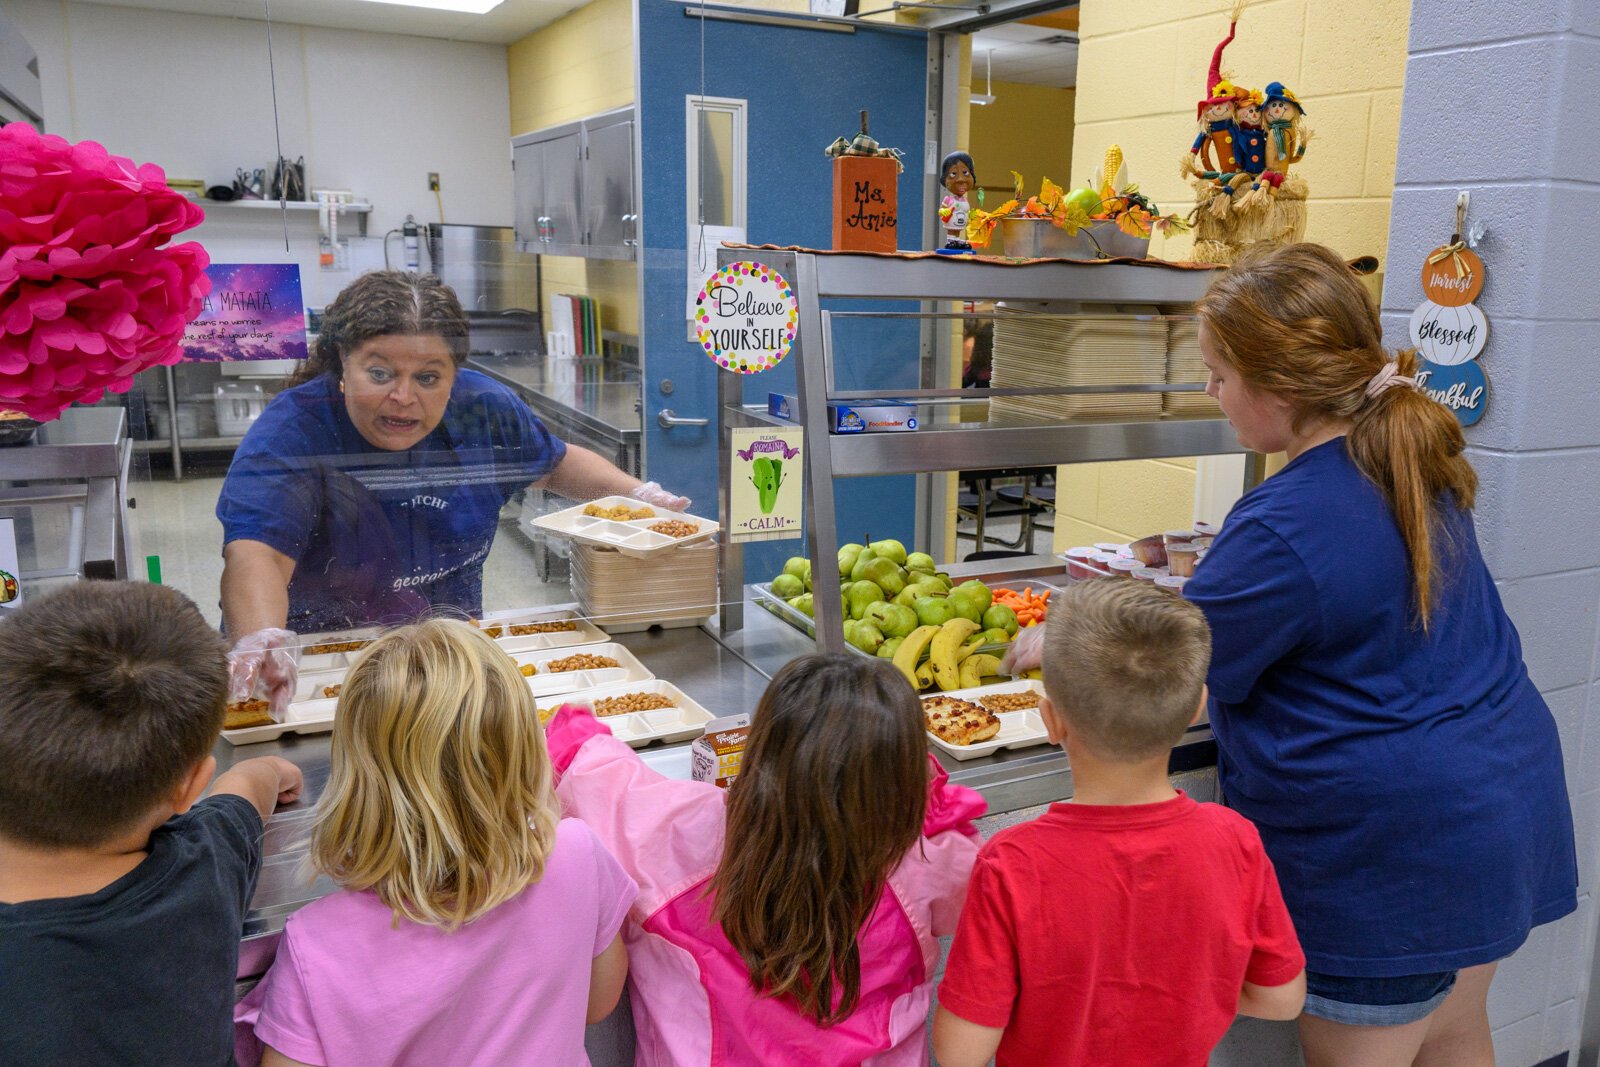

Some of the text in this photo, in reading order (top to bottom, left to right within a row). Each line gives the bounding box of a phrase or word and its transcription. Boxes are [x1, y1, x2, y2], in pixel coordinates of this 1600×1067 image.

[855, 181, 885, 204] Ms.
[846, 200, 897, 232] Amie
[1430, 271, 1475, 293] Harvest
[203, 291, 273, 312] A MATATA
[709, 285, 785, 318] Believe
[185, 319, 217, 327] means
[746, 317, 754, 327] IN
[1418, 319, 1478, 346] Blessed
[198, 331, 216, 340] rest
[217, 327, 226, 340] of
[228, 332, 249, 343] your
[710, 328, 785, 350] YOURSELF
[753, 440, 785, 452] ROMAINE
[748, 516, 785, 530] CALM
[719, 754, 743, 766] LOC
